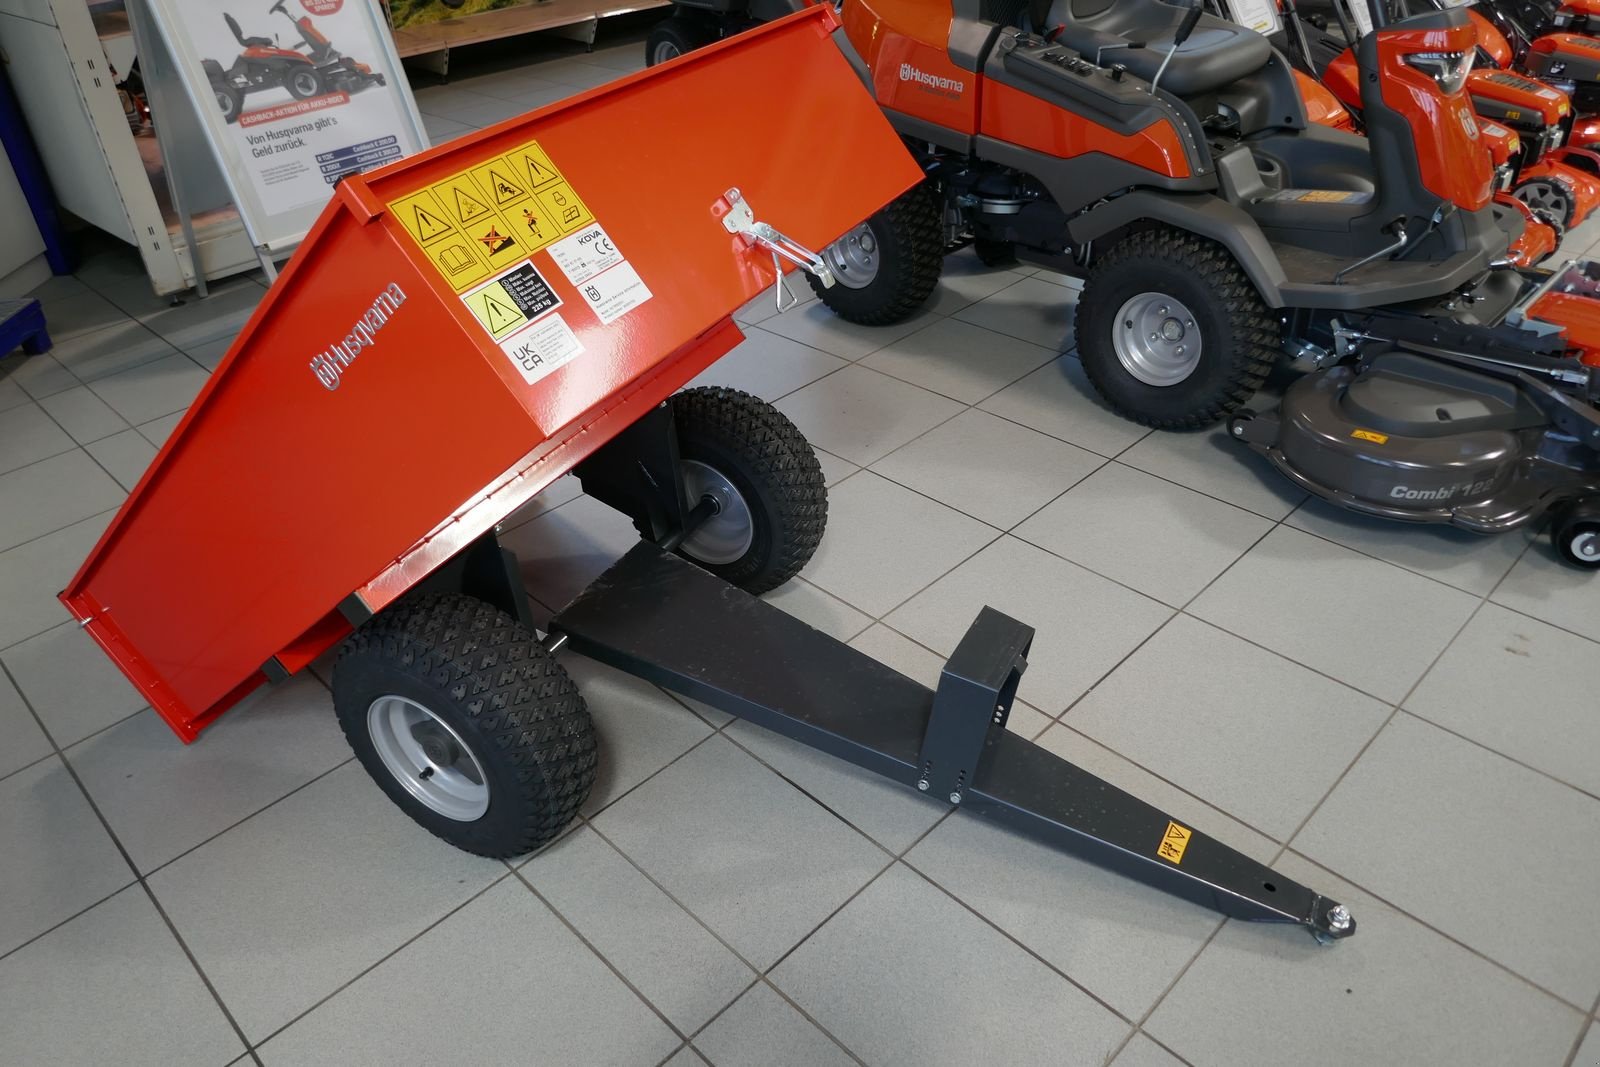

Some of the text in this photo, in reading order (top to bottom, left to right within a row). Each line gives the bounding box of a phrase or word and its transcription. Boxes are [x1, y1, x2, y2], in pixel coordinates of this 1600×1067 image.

[910, 67, 964, 93] Husqvarna
[246, 116, 338, 146] Von Husqvarna gibt's
[252, 138, 307, 158] Geld zurück.
[578, 230, 602, 246] KOVA
[531, 303, 544, 312] 225
[324, 282, 407, 374] Husqvarna
[1390, 478, 1495, 500] Combi 122
